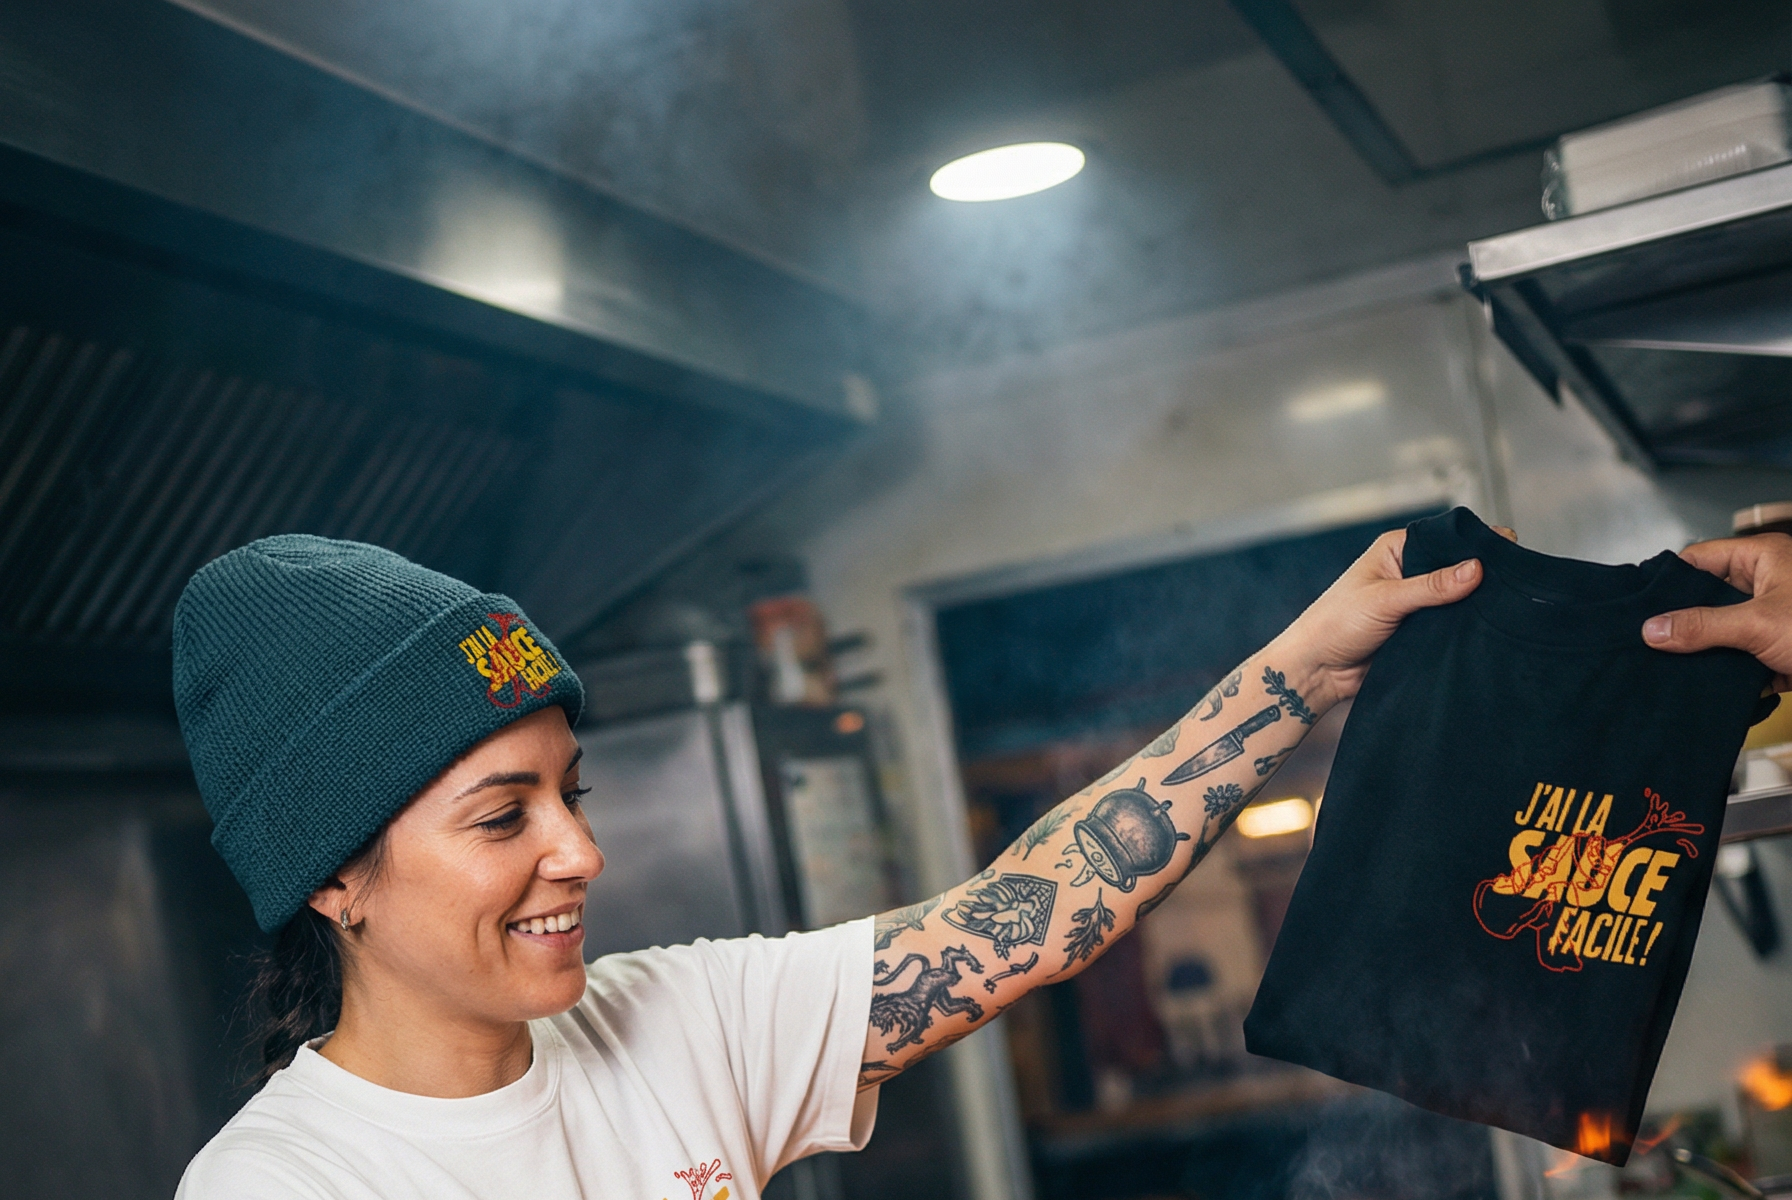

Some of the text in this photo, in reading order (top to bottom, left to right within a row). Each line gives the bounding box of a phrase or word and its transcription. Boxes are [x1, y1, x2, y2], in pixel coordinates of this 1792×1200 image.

[476, 626, 544, 693] SAUCE
[1514, 782, 1614, 836] J'AI LA
[1492, 829, 1681, 917] SAUCE
